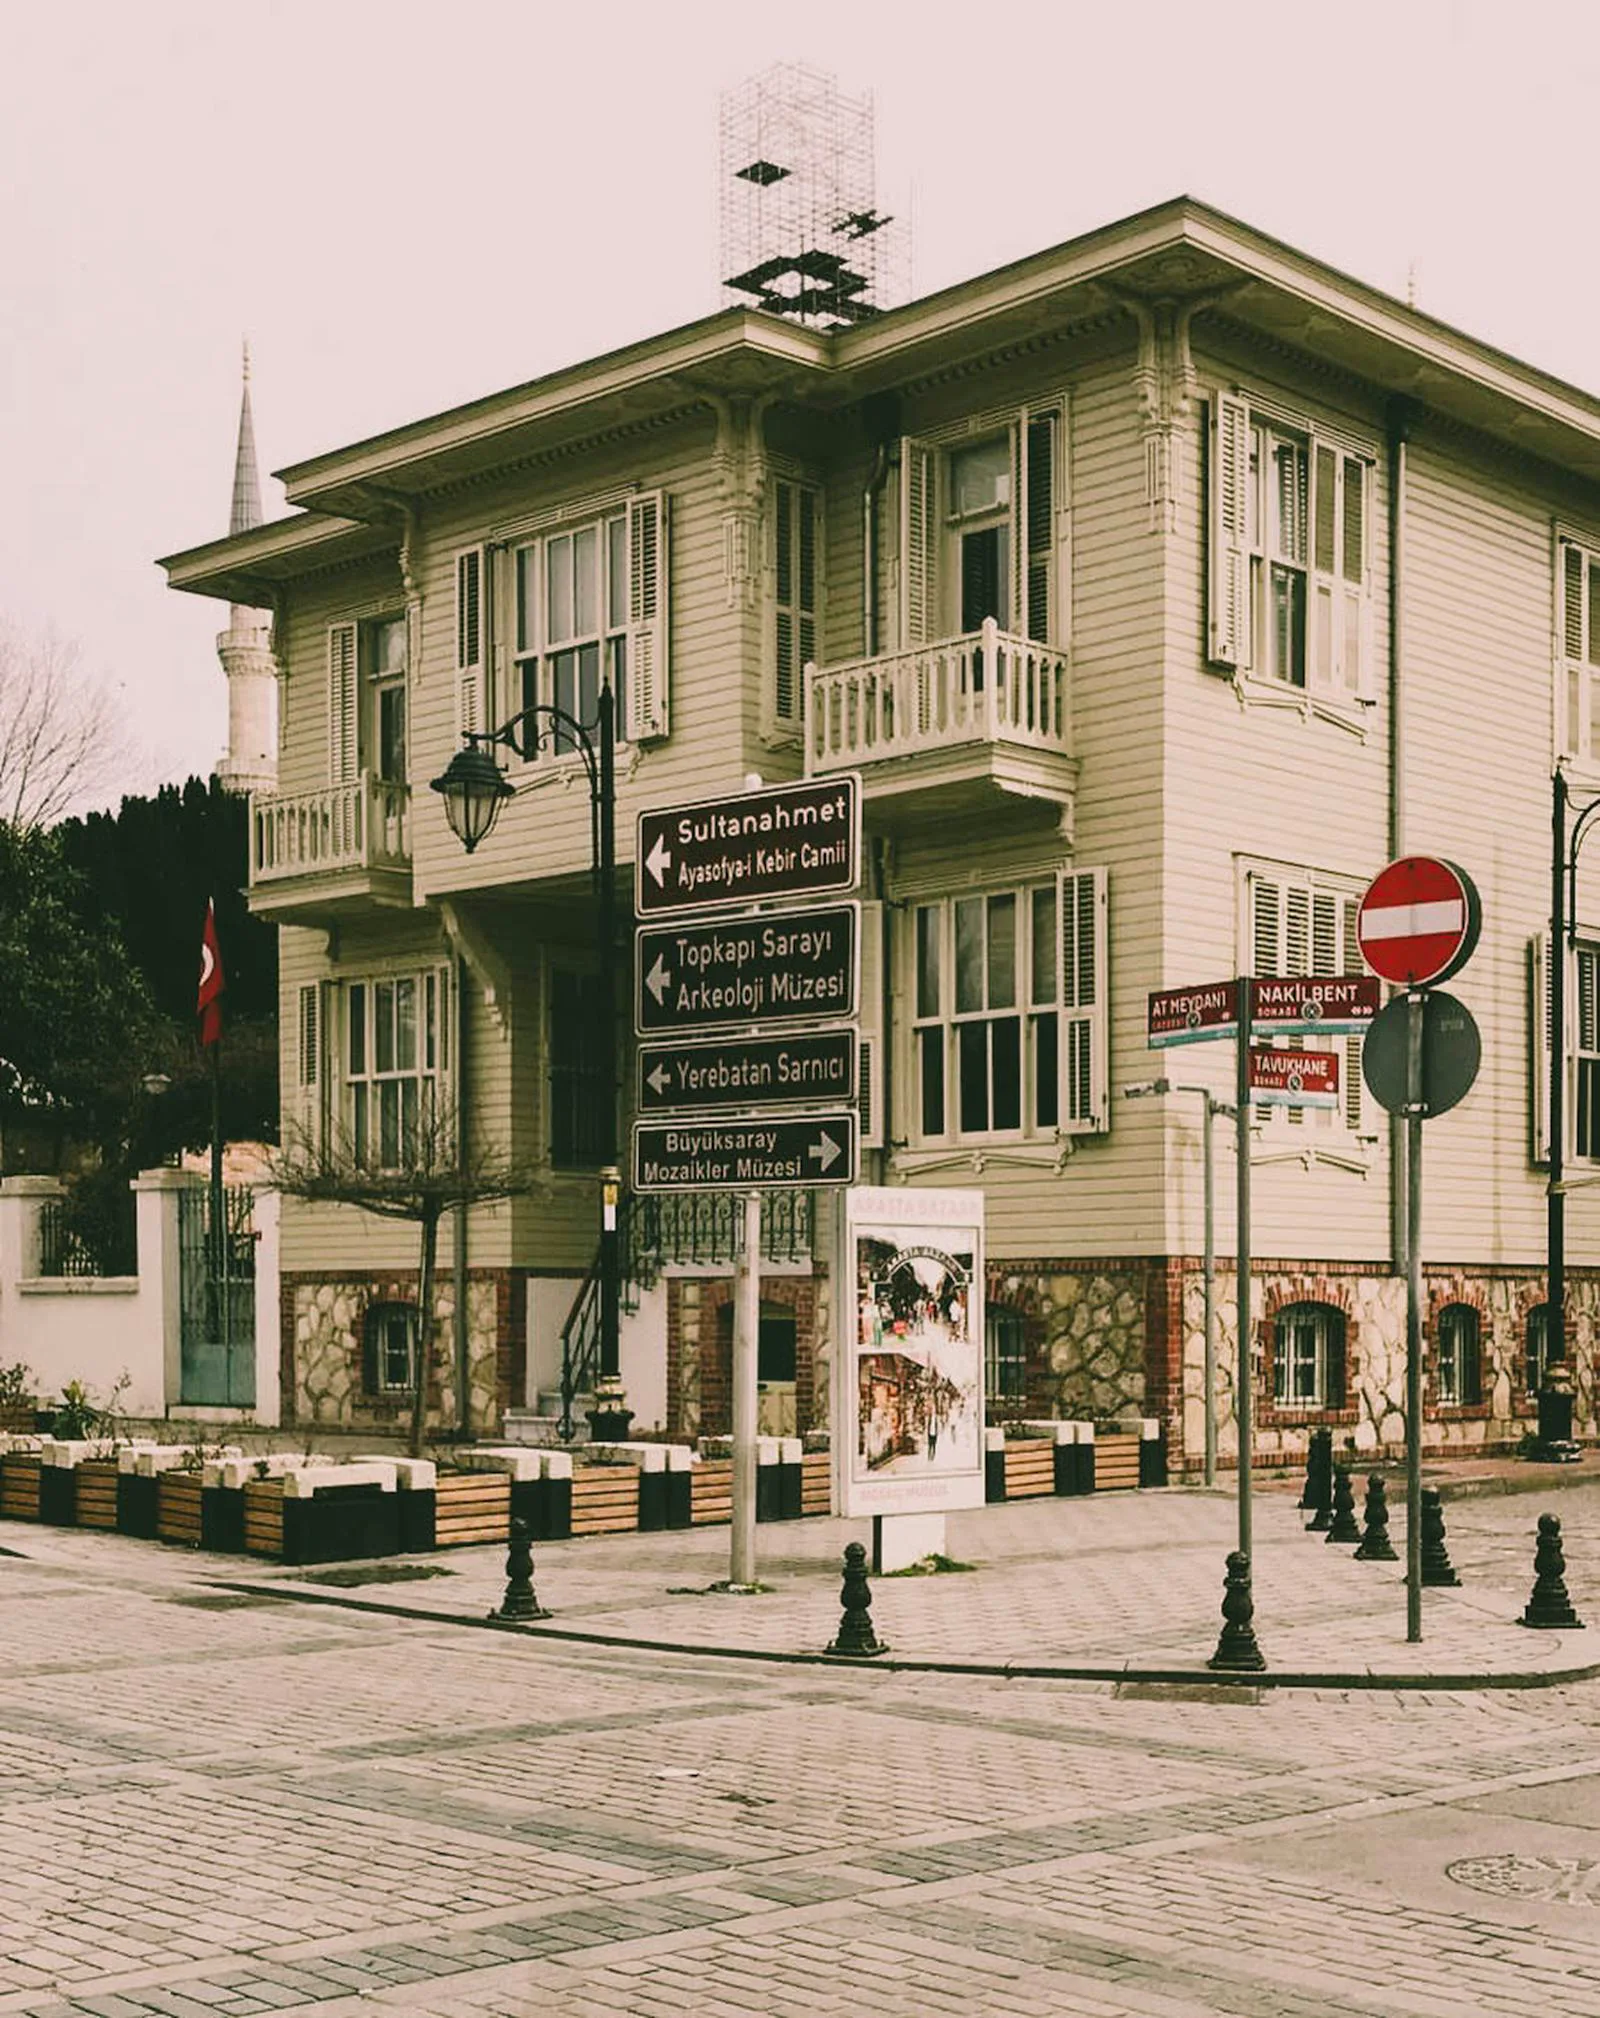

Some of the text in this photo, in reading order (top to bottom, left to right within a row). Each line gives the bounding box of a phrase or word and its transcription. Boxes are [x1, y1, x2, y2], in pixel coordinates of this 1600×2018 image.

[678, 796, 846, 844] Sultanahmet
[756, 847, 796, 874] Kebir
[801, 840, 846, 868] Camii
[676, 928, 831, 973] Topkapı Sarayı
[676, 969, 844, 1013] Arkeoloji Müzesi
[1152, 990, 1227, 1018] AT MEYDANI
[676, 1052, 844, 1090] Yerebatan Sarnıcı
[1254, 1055, 1328, 1077] TAVUKHANE
[666, 1131, 777, 1156] Büyüksaray
[644, 1156, 801, 1182] Mozaikler Müzesi
